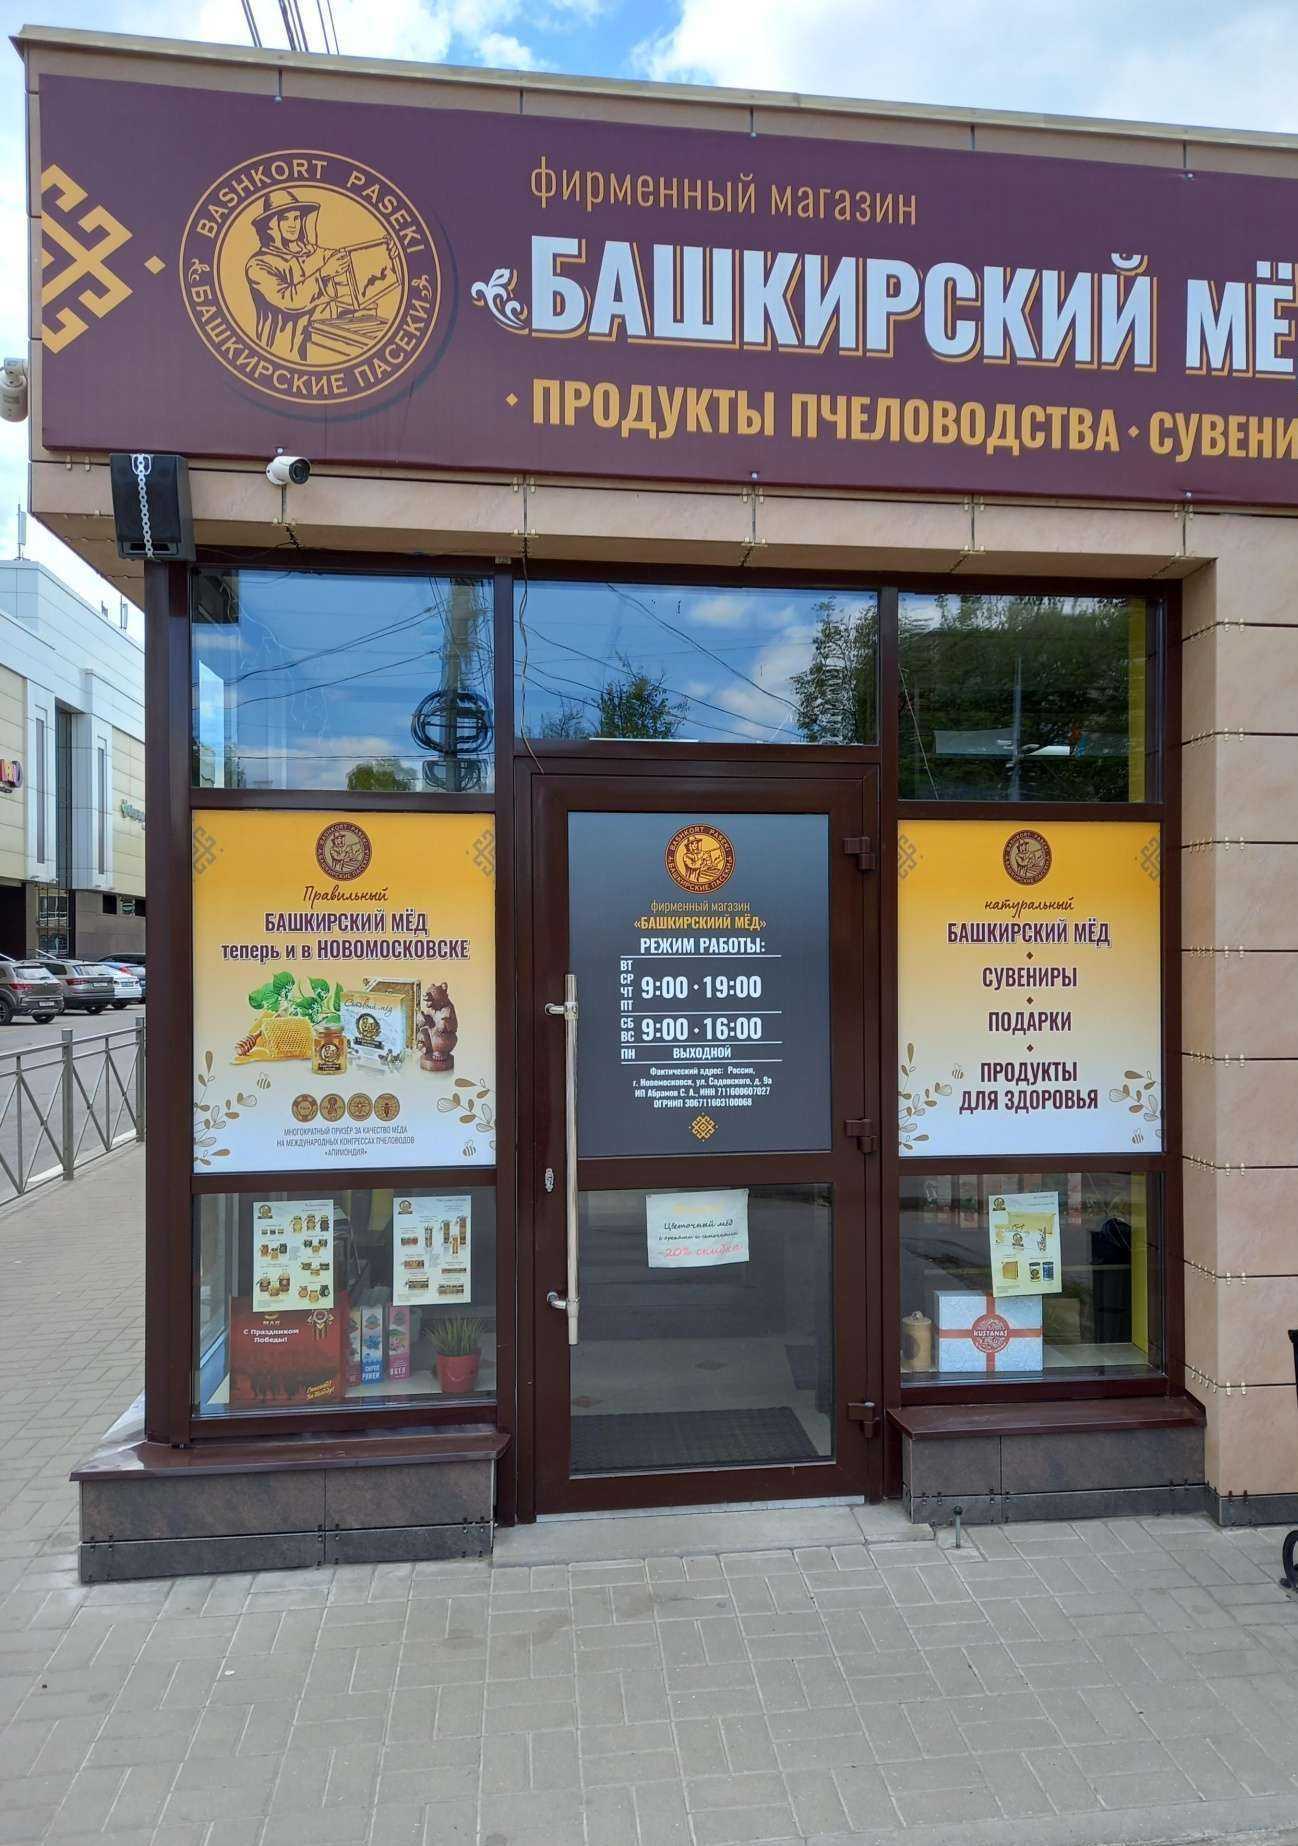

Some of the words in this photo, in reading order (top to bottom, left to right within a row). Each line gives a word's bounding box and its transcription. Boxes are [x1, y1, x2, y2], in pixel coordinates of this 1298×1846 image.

[530, 155, 756, 214] фирменный
[771, 184, 918, 225] магазин
[196, 159, 327, 239] BASHKORT
[346, 171, 425, 253] PASEKI
[530, 234, 1158, 373] БАШКИРСКИЙ
[190, 286, 348, 395] БАШКИРСКИЕ
[354, 299, 431, 387] ПАСЕКИ
[532, 378, 774, 440] ПРОДУКТЫ
[791, 393, 1120, 456] ПЧЕЛОВОДСТВА
[1150, 411, 1298, 463] СУВЕНИ
[303, 884, 389, 909] Правильный
[650, 899, 709, 914] фирменный
[711, 901, 751, 912] магазин
[984, 896, 1076, 918] натуральный
[264, 908, 386, 934] БАШКИРСКИЙ
[391, 908, 429, 936] МЁД
[735, 913, 767, 932] МЁД»
[947, 918, 1069, 944] БАШКИРСКИЙ
[1074, 917, 1112, 948] МЁД
[221, 942, 280, 964] теперь
[286, 943, 295, 959] и
[301, 943, 312, 959] в
[317, 939, 470, 960] НОВОМОСКОВСКЕ
[640, 937, 695, 954] РЕЖИМ
[700, 937, 766, 954] РАБОТЫ:
[620, 960, 633, 971] ВТ
[620, 973, 634, 985] СР
[641, 976, 688, 999] 9:00
[703, 975, 762, 999] 19:00
[982, 967, 1077, 990] СУВЕНИРЫ
[620, 987, 634, 998] ЧТ
[620, 1000, 634, 1011] ПТ
[620, 1017, 635, 1029] СБ
[641, 1018, 689, 1041] 9:00
[703, 1017, 762, 1040] 16:00
[988, 1011, 1072, 1035] ПОДАРКИ
[620, 1031, 635, 1042] ВС
[620, 1048, 636, 1060] ПН
[673, 1045, 732, 1060] ВЫХОДНОЙ
[650, 1066, 698, 1076] Фактический
[700, 1067, 723, 1076] адрес:
[980, 1061, 1078, 1086] ПРОДУКТЫ
[717, 1086, 771, 1096] 711600607027
[959, 1090, 999, 1114] ДЛЯ
[1004, 1089, 1099, 1114] ЗДОРОВЬЯ
[276, 1139, 285, 1147] НА
[286, 1138, 339, 1147] МЕЖДУНАРОДНЫХ
[339, 1137, 375, 1146] КОНГРЕССАХ
[283, 1126, 331, 1136] МНОГОКРАТНЫЙ
[354, 1126, 362, 1135] ЗА
[362, 1126, 392, 1135] КАЧЕСТВО
[250, 1328, 300, 1337] Праздником
